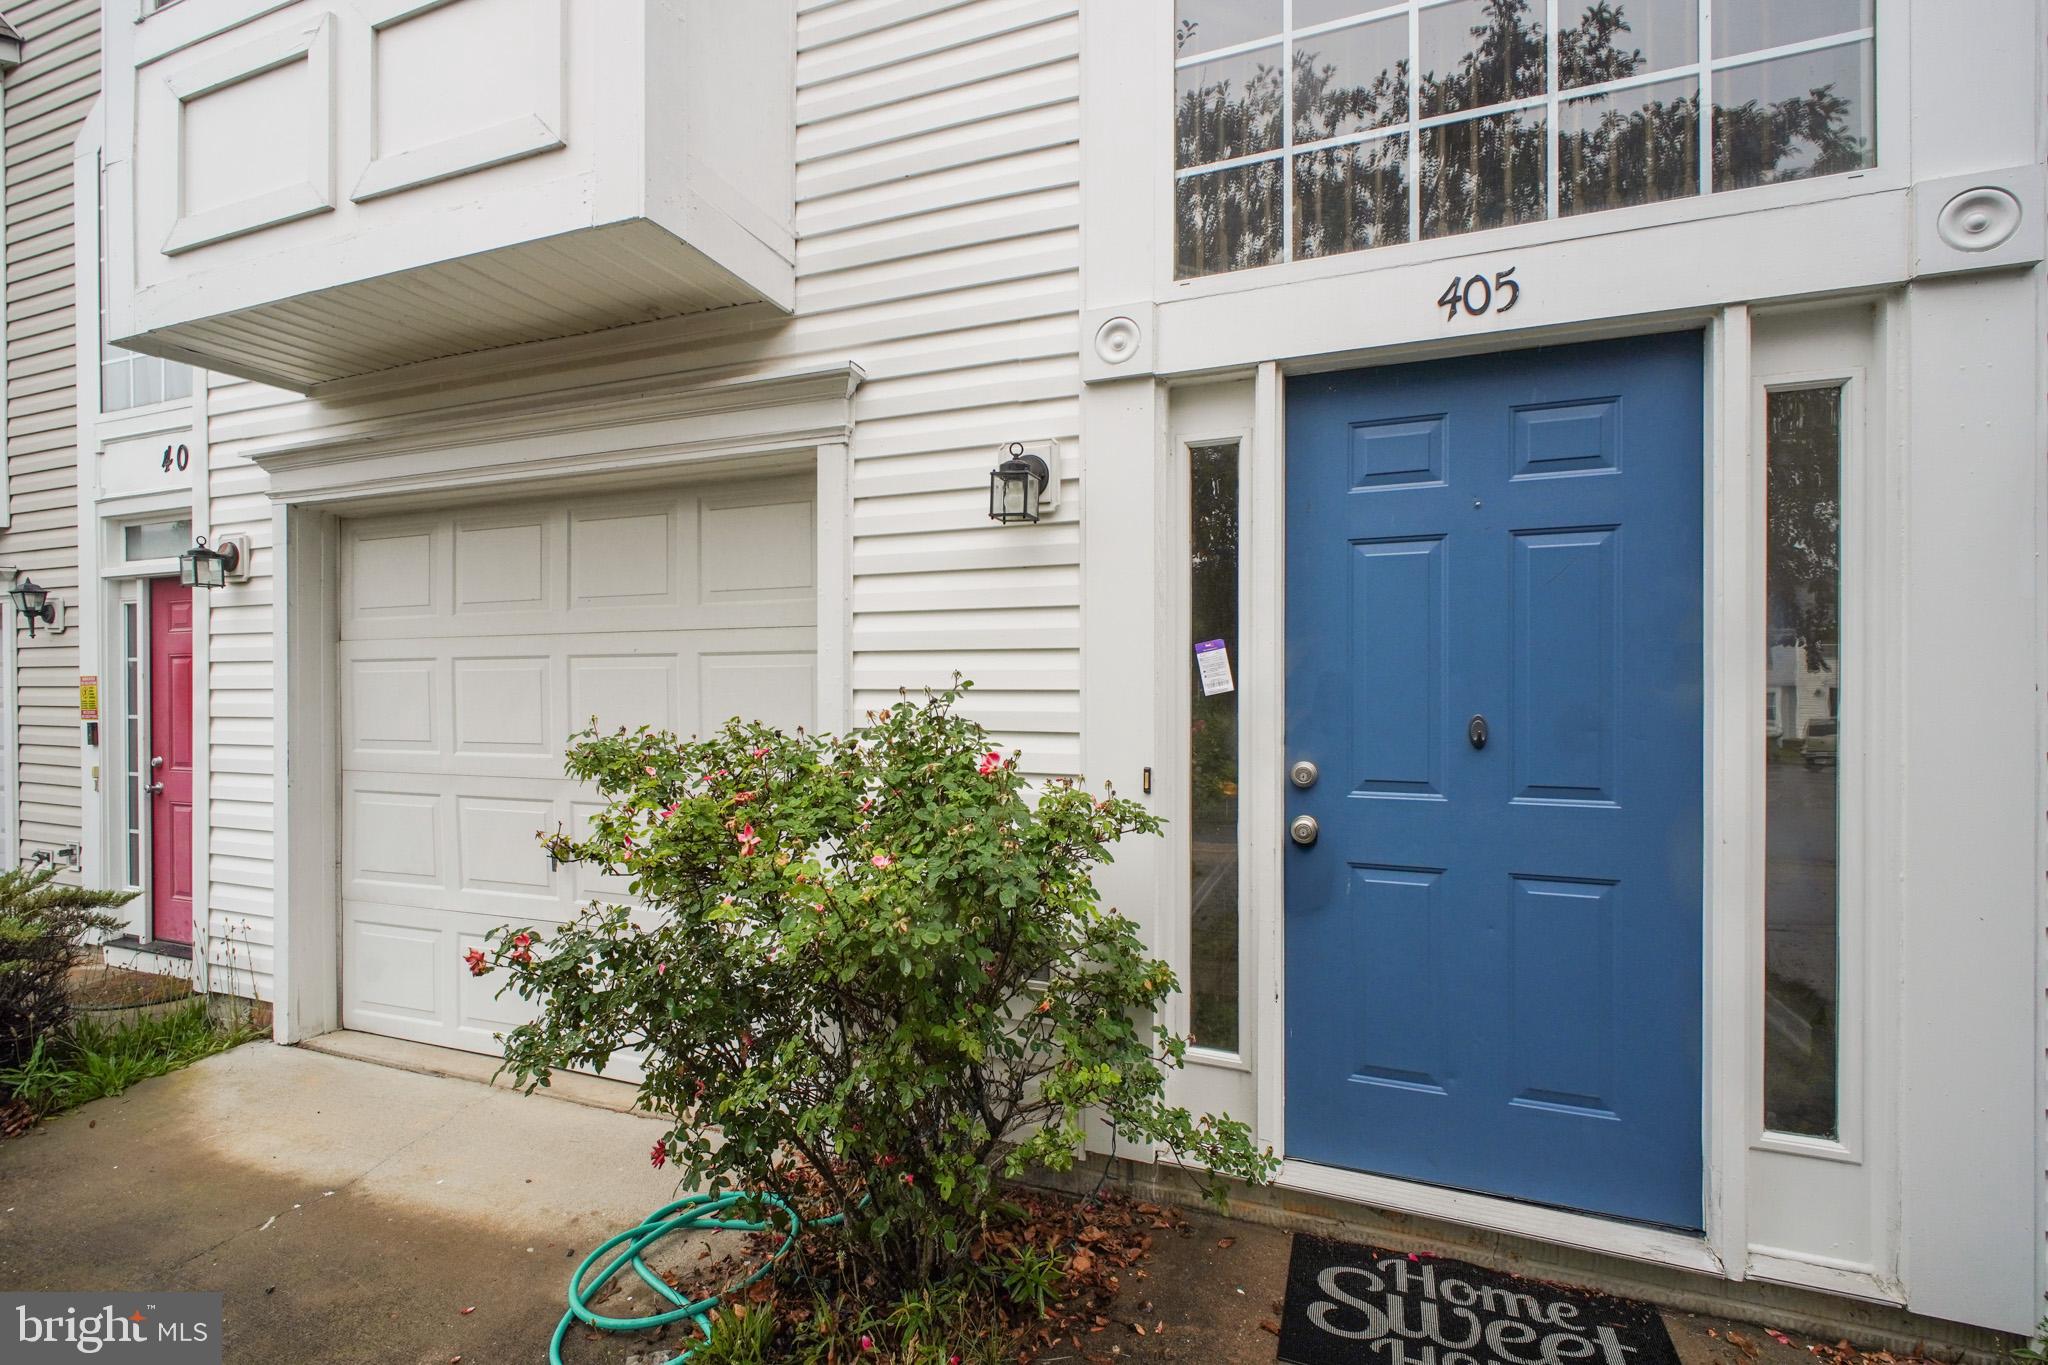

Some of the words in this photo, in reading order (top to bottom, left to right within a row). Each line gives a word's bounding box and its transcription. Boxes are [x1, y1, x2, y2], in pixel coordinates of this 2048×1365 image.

[1437, 266, 1520, 322] 405
[1306, 1266, 1638, 1365] Sweet
[1376, 1258, 1587, 1331] Home
